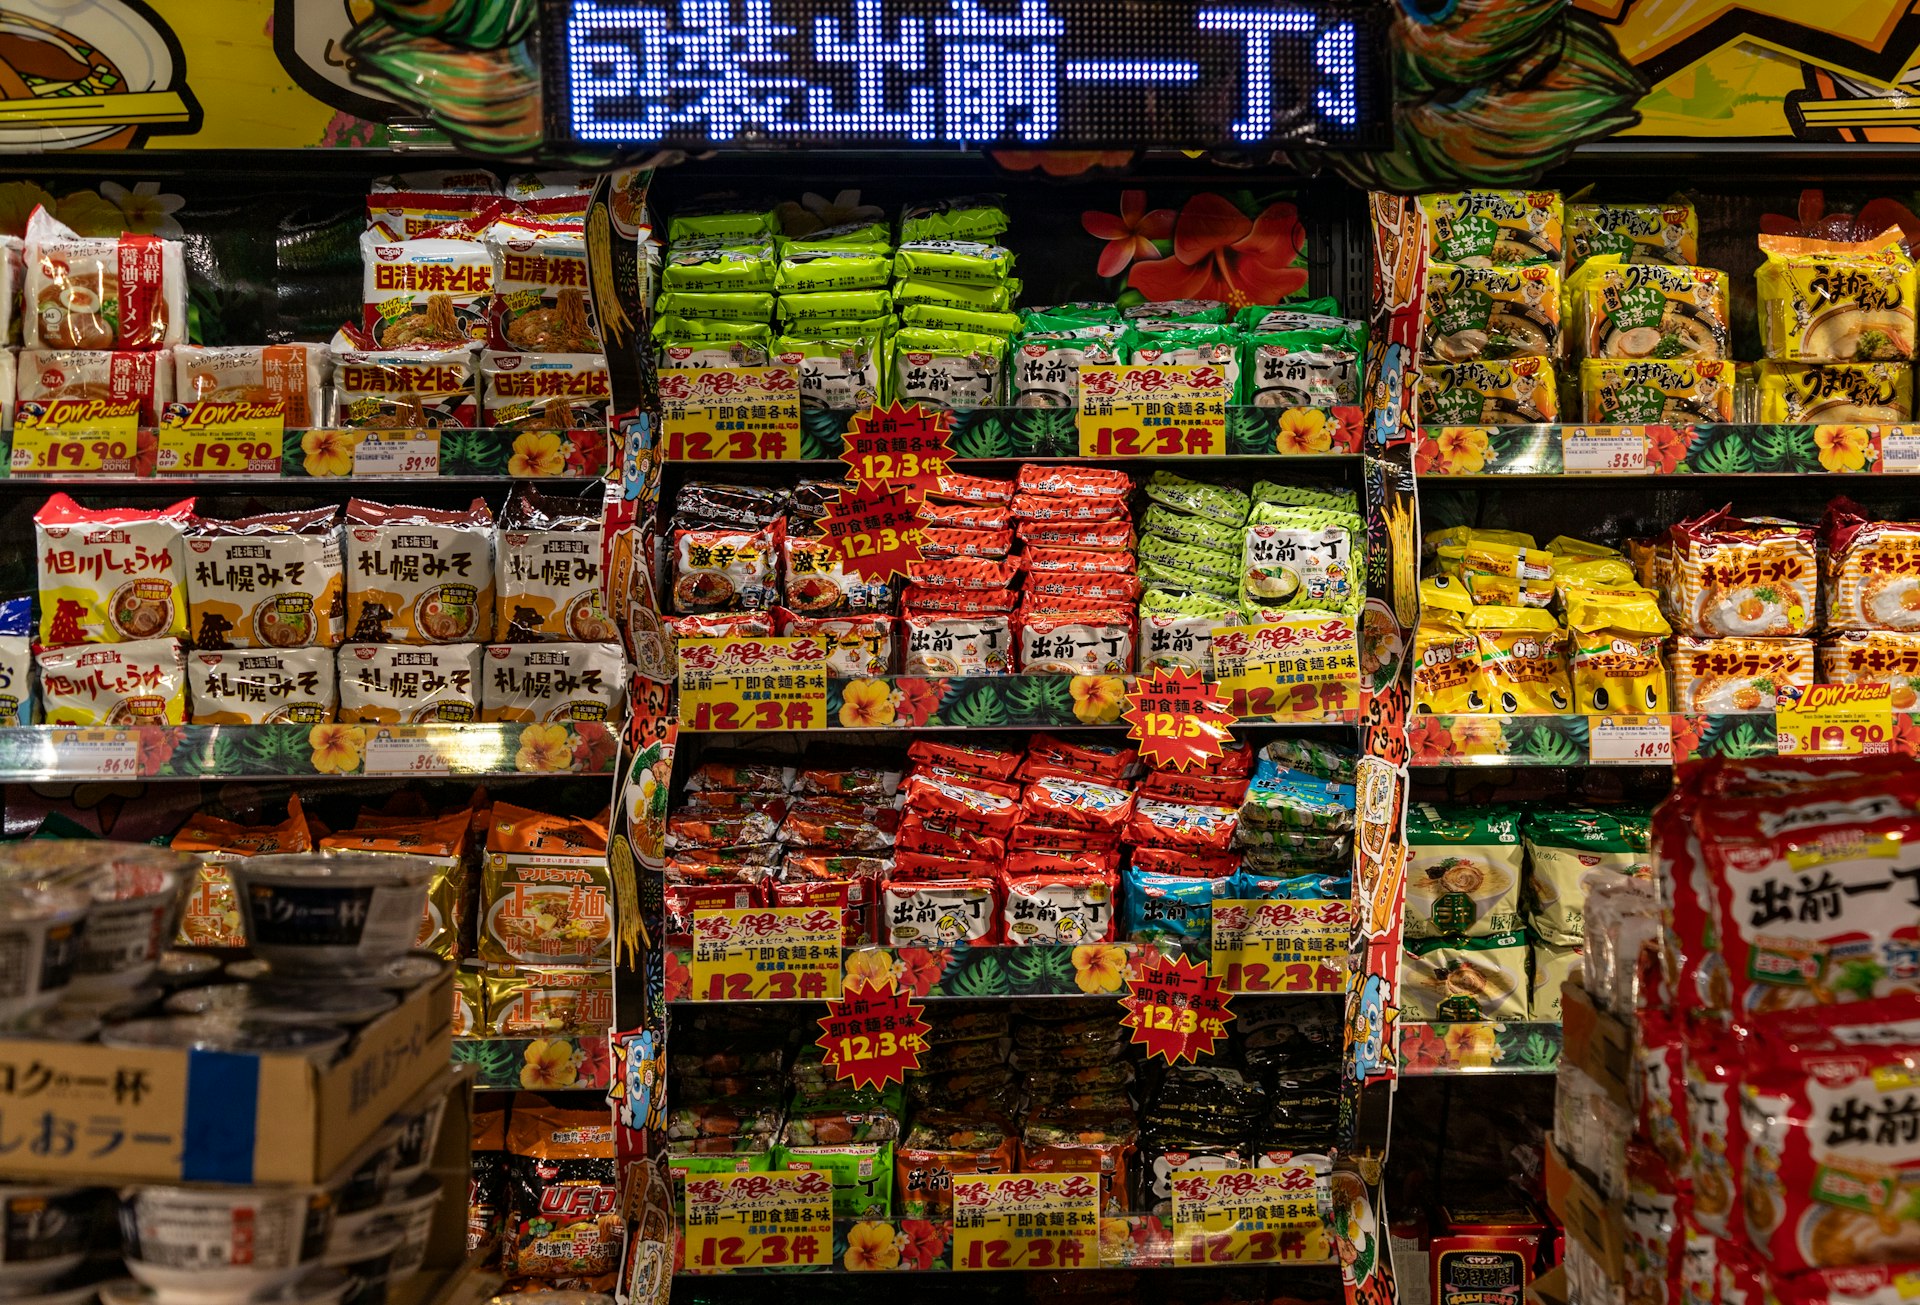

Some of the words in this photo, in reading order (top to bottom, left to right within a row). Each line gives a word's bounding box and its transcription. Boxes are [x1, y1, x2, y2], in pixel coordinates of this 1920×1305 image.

[1453, 217, 1493, 235] からし
[376, 265, 491, 292] 日清焼そば
[120, 248, 139, 339] 醤油ラーメン
[1449, 289, 1488, 306] からし
[1621, 288, 1660, 306] からし
[288, 349, 304, 393] 大黒軒
[344, 366, 462, 392] 日清焼そば
[906, 370, 997, 394] 出前一丁
[1263, 359, 1356, 381] 出前一丁
[494, 371, 610, 397] 日清焼そば
[865, 416, 930, 435] 出前一丁
[14, 449, 32, 459] 28%
[37, 442, 126, 467] $19.90
[159, 450, 177, 459] 28%
[184, 442, 272, 467] $19.90
[856, 437, 941, 453] 即食麵各味
[853, 454, 945, 478] $12/3件
[834, 492, 899, 517] 出前一丁
[829, 509, 916, 537] 即食麵各味
[90, 531, 124, 543] 北海道
[399, 536, 432, 548] 北海道
[836, 528, 924, 561] $12/3件
[232, 546, 265, 558] 北海道
[1253, 538, 1342, 561] 出前一丁
[45, 546, 173, 580] 旭川しょうゆ
[358, 551, 472, 583] 札幌みそ
[1700, 558, 1804, 588] チキンラーメン
[195, 561, 305, 592] 札幌みそ
[911, 627, 1004, 653] 出前一丁
[1030, 634, 1123, 659] 出前一丁
[243, 657, 277, 669] 北海道
[399, 653, 432, 665] 北海道
[1691, 653, 1800, 676] チキンラーメン
[45, 665, 163, 700] 旭川しょうゆ
[205, 670, 320, 703] 札幌みそ
[358, 667, 471, 699] 札幌みそ
[495, 667, 603, 698] 札幌みそ
[1148, 680, 1213, 695] 出前一丁
[1140, 698, 1228, 715] 即食麵各味
[1135, 714, 1226, 738] $12/3件
[1634, 742, 1669, 757] $14.90
[516, 868, 593, 883] マルちゃん
[499, 882, 607, 921] 正麺
[893, 898, 987, 925] 出前一丁
[1014, 899, 1106, 923] 出前一丁
[506, 936, 597, 956] 味噌味
[524, 973, 599, 986] マルちゃん
[1148, 969, 1213, 988] 出前一丁
[507, 988, 612, 1026] 正麺
[837, 994, 903, 1017] 出前一丁
[1137, 987, 1221, 1011] 即食麵各味
[830, 1017, 916, 1038] 即食麵各味
[1132, 1005, 1223, 1038] $12/3件
[832, 1033, 922, 1064] $12/3件
[789, 1162, 810, 1170] NISSIN
[1455, 1268, 1510, 1286] やきそば
